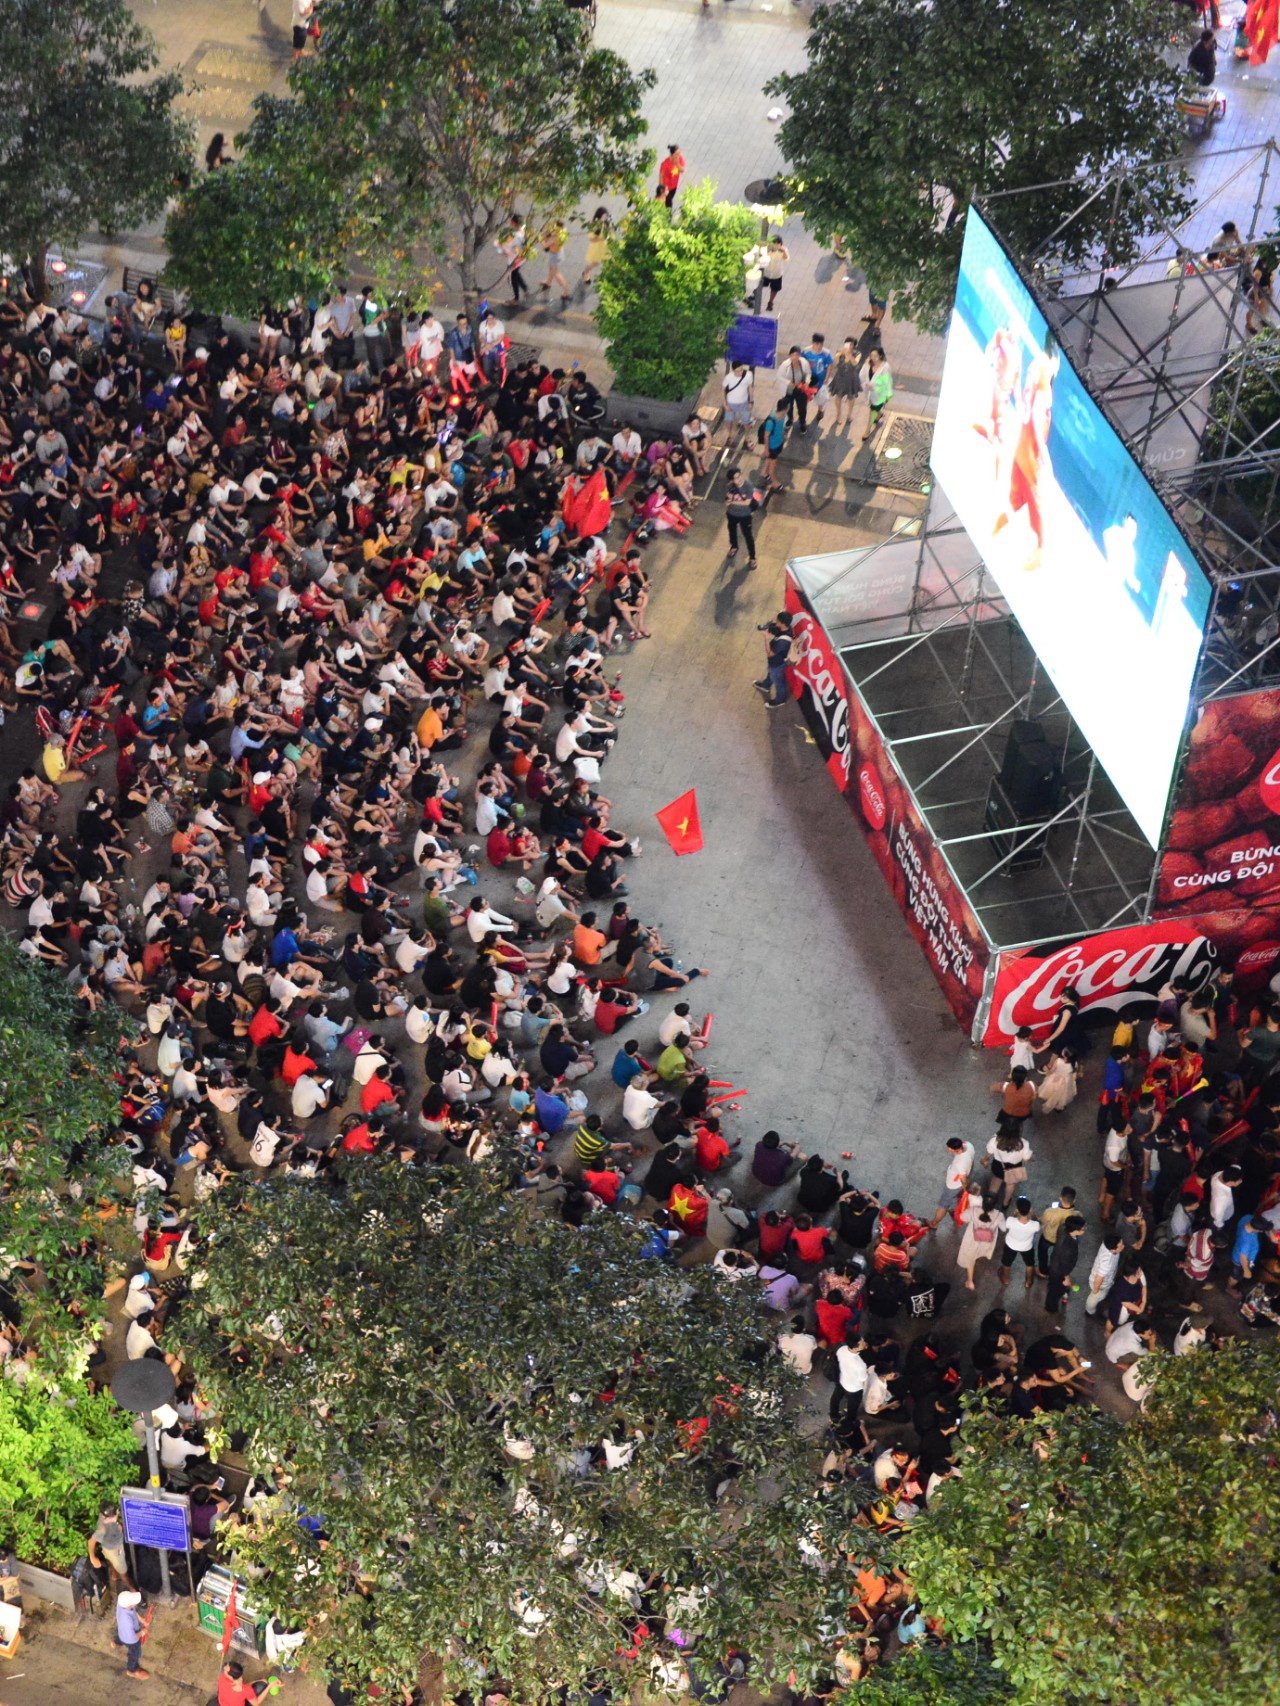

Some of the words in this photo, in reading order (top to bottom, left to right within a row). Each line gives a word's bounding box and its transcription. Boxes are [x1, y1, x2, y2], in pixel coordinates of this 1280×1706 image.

[1173, 869, 1232, 888] CÙNG
[1237, 861, 1275, 880] ĐỘI
[910, 889, 929, 930] VIỆT
[929, 929, 949, 974] NAM
